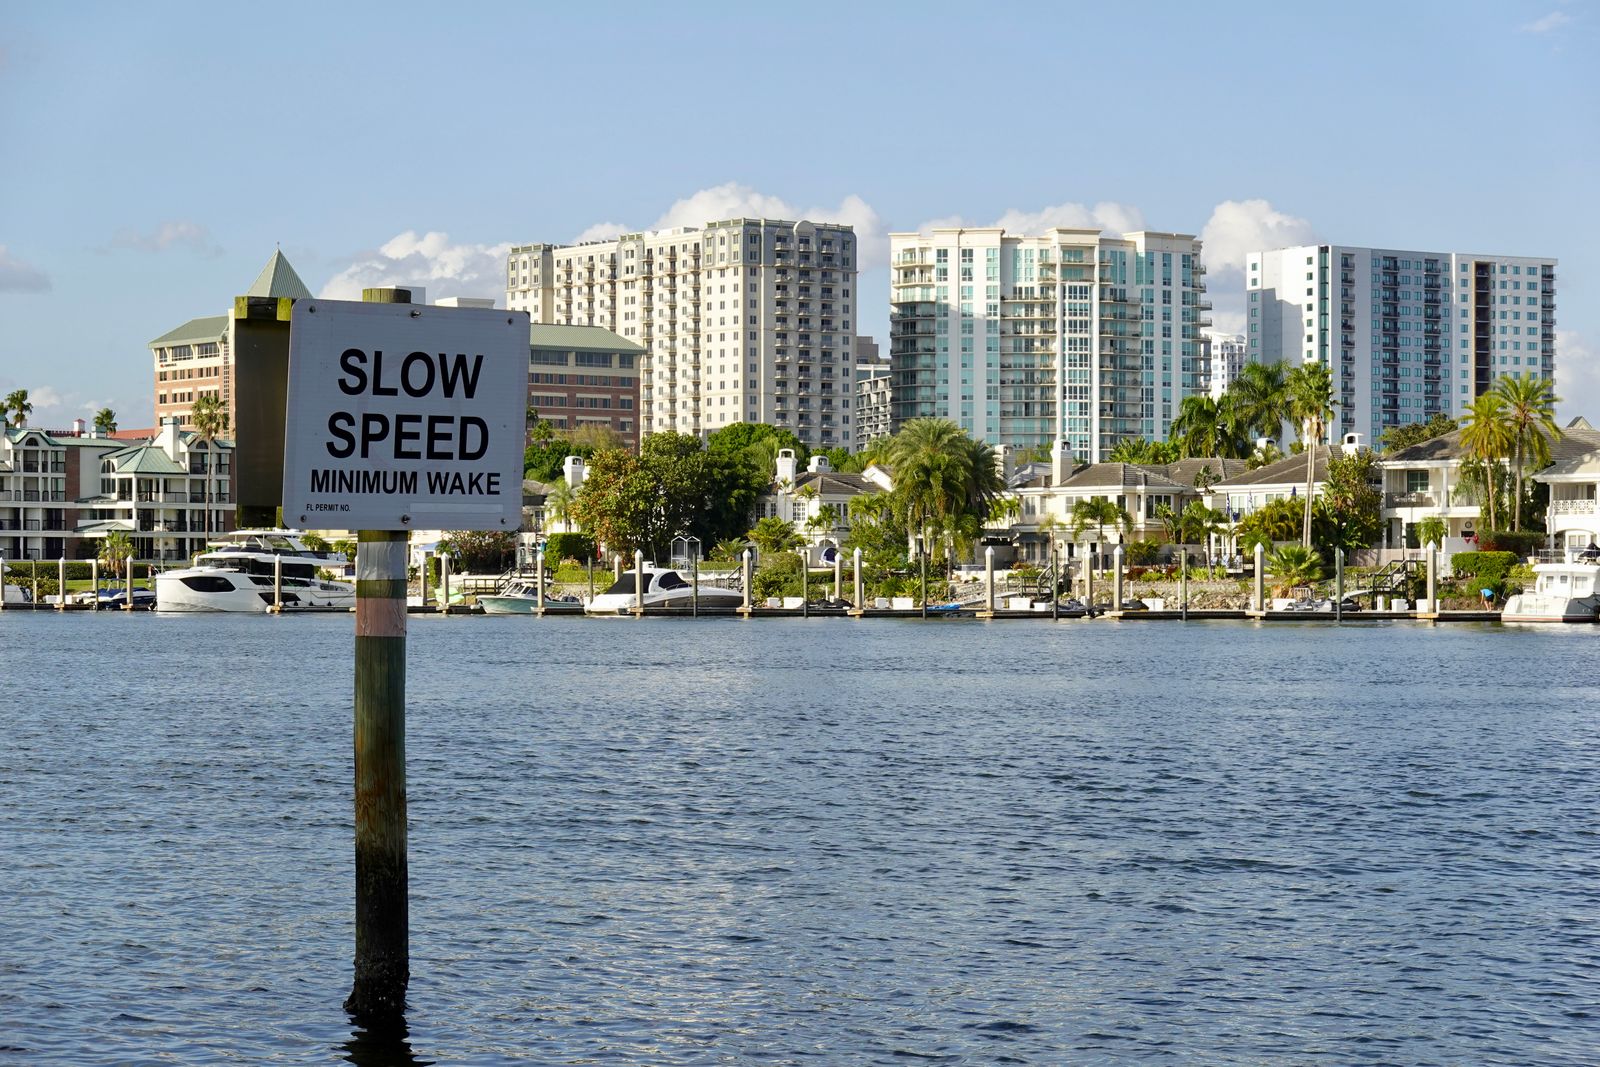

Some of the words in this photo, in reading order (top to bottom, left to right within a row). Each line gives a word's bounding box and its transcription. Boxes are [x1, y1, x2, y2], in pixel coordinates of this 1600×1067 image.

[338, 348, 484, 399] SLOW
[326, 411, 489, 461] SPEED
[311, 469, 418, 495] MINIMUM
[426, 471, 501, 496] WAKE
[306, 503, 314, 511] FL
[315, 503, 338, 512] PERMIT
[340, 504, 351, 512] NO.
